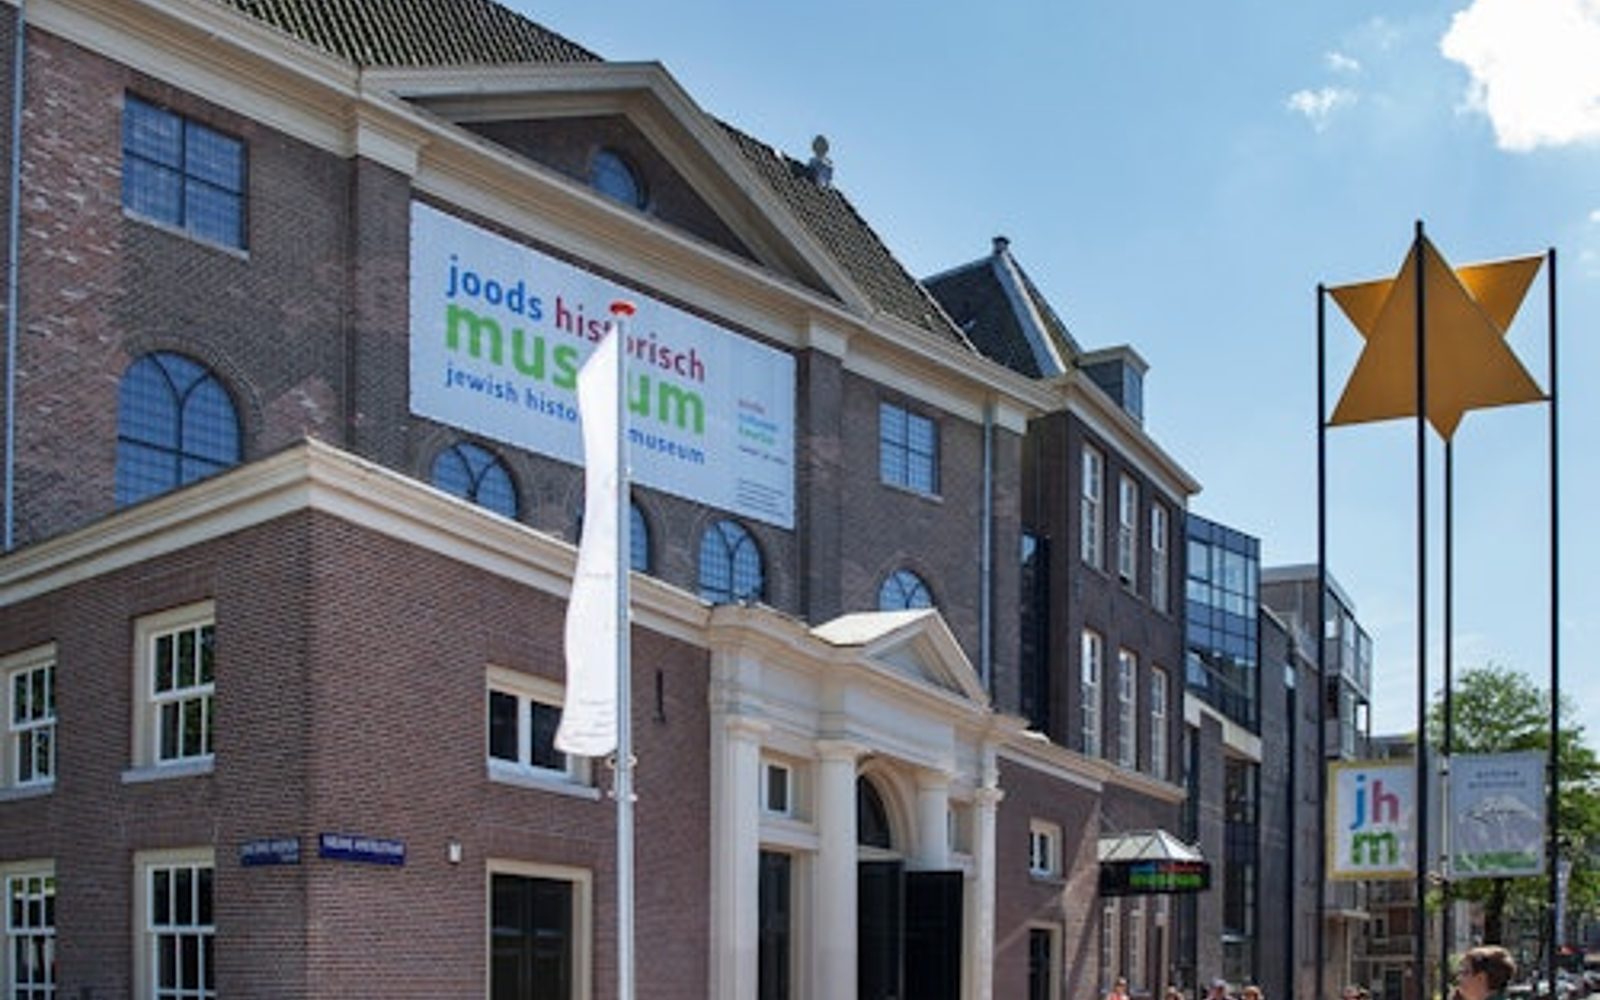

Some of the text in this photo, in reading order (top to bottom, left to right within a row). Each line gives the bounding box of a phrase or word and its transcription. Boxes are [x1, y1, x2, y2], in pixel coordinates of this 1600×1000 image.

[445, 303, 705, 436] musum
[446, 255, 705, 384] joods hisrisch
[446, 362, 519, 403] jewish
[525, 387, 578, 424] histo
[627, 427, 705, 465] museum
[1350, 774, 1400, 830] jh
[1352, 831, 1398, 866] m
